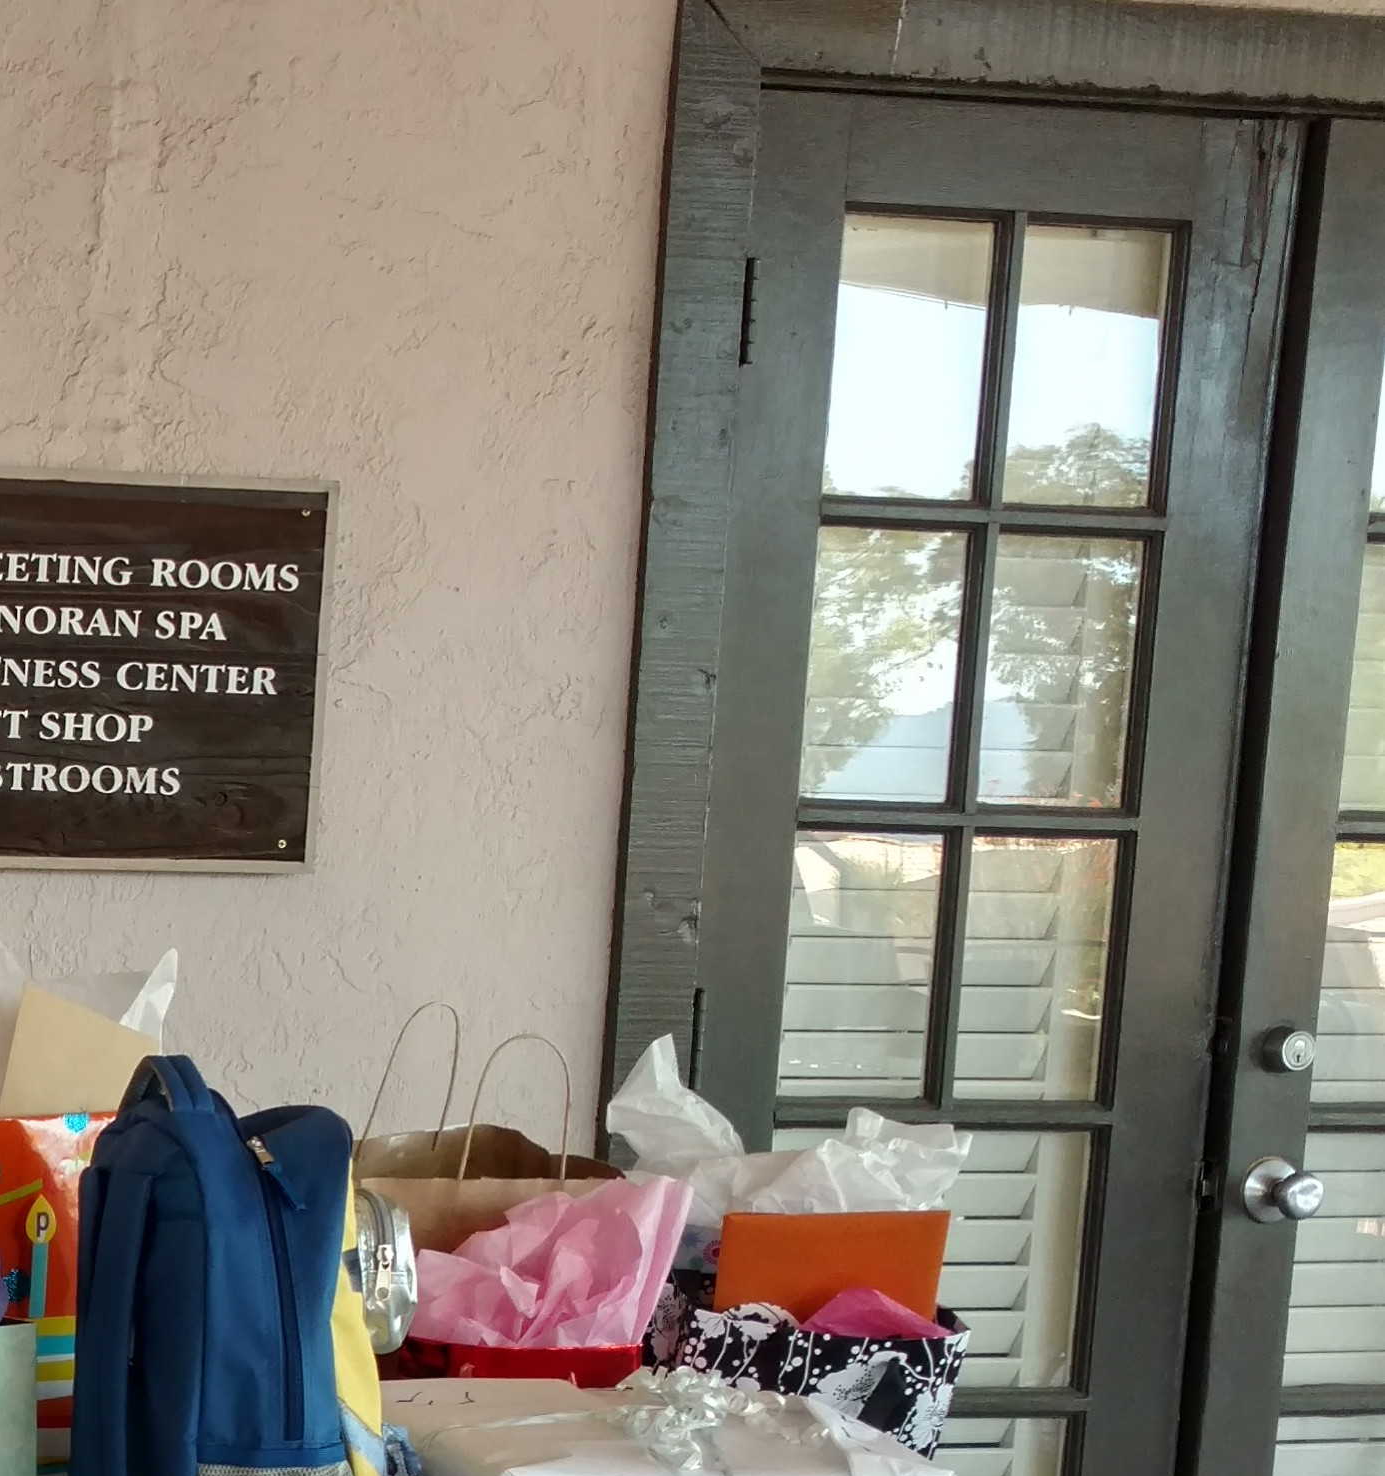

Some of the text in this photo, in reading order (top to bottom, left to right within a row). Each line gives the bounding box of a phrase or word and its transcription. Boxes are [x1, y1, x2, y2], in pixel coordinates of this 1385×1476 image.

[150, 558, 300, 592] ROOMS
[155, 611, 227, 641] SPA
[116, 662, 277, 695] CENTER
[39, 711, 153, 743] SHOP
